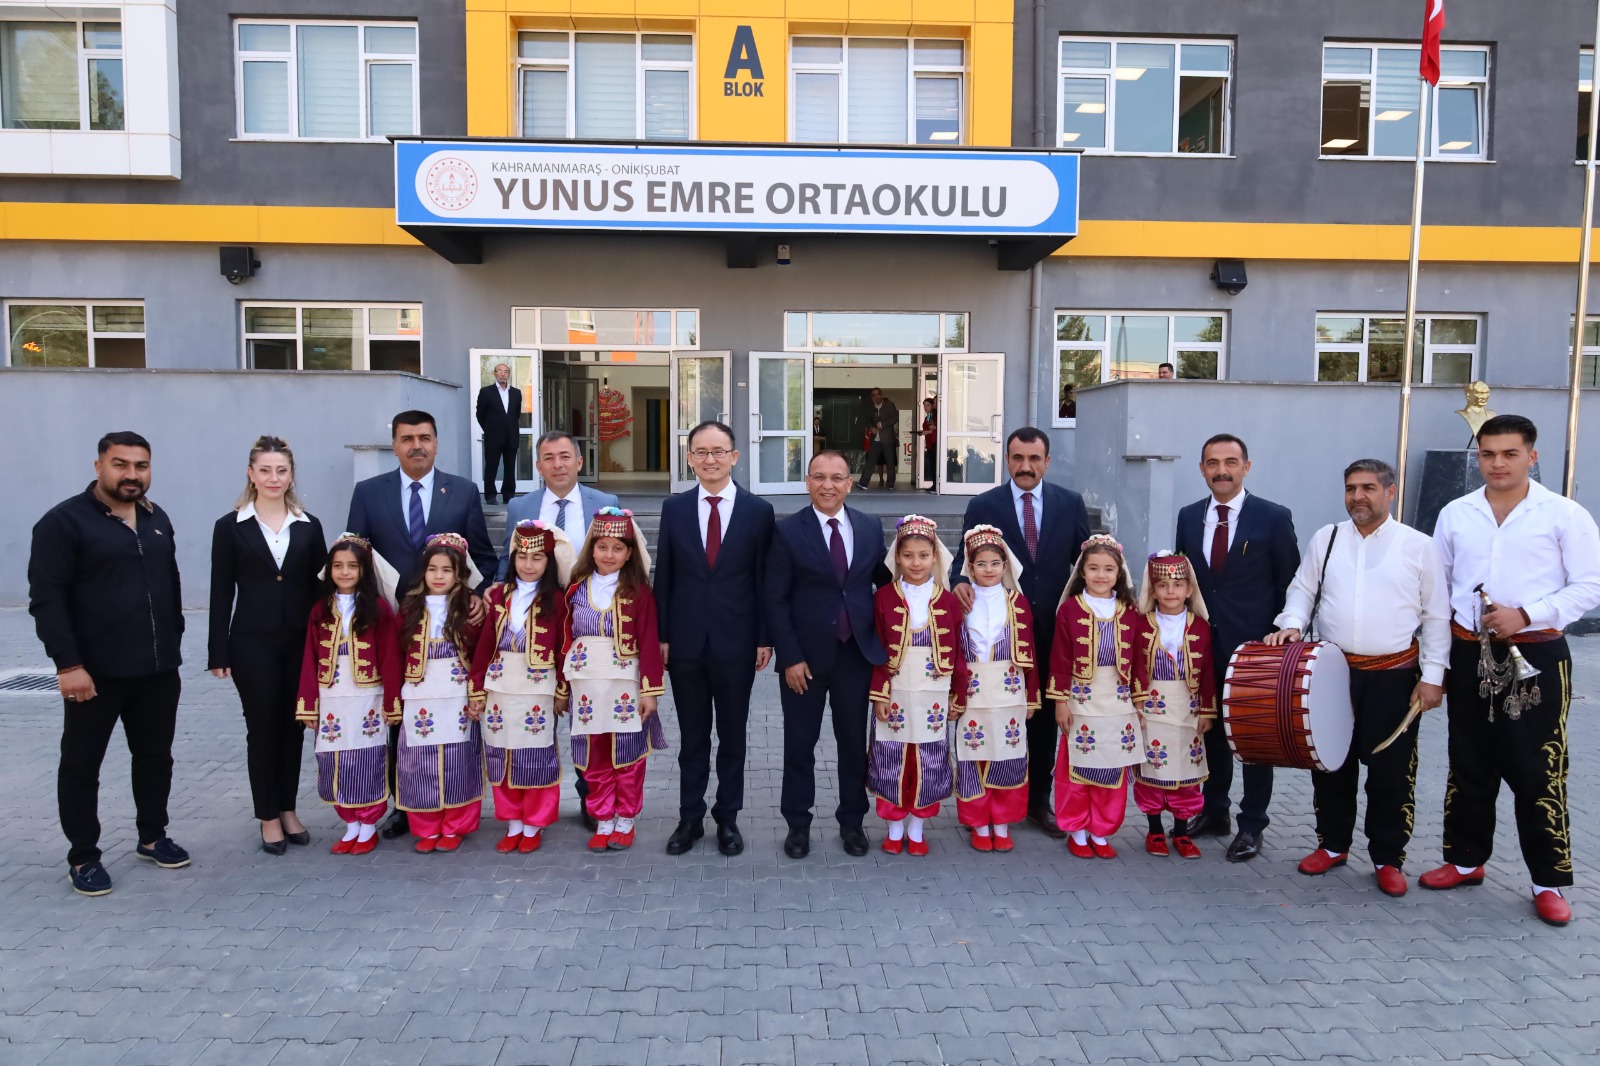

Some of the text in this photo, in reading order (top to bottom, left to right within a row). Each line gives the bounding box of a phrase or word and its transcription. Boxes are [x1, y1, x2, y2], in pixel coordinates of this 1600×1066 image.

[724, 25, 765, 79] A
[724, 82, 764, 97] BLOK
[491, 162, 602, 177] KAHRAMANMARAŞ
[611, 163, 681, 177] ONİKİŞUBAT
[493, 177, 634, 212] YUNUS
[647, 181, 755, 214] EMRE
[766, 182, 1006, 217] ORTAOKULU
